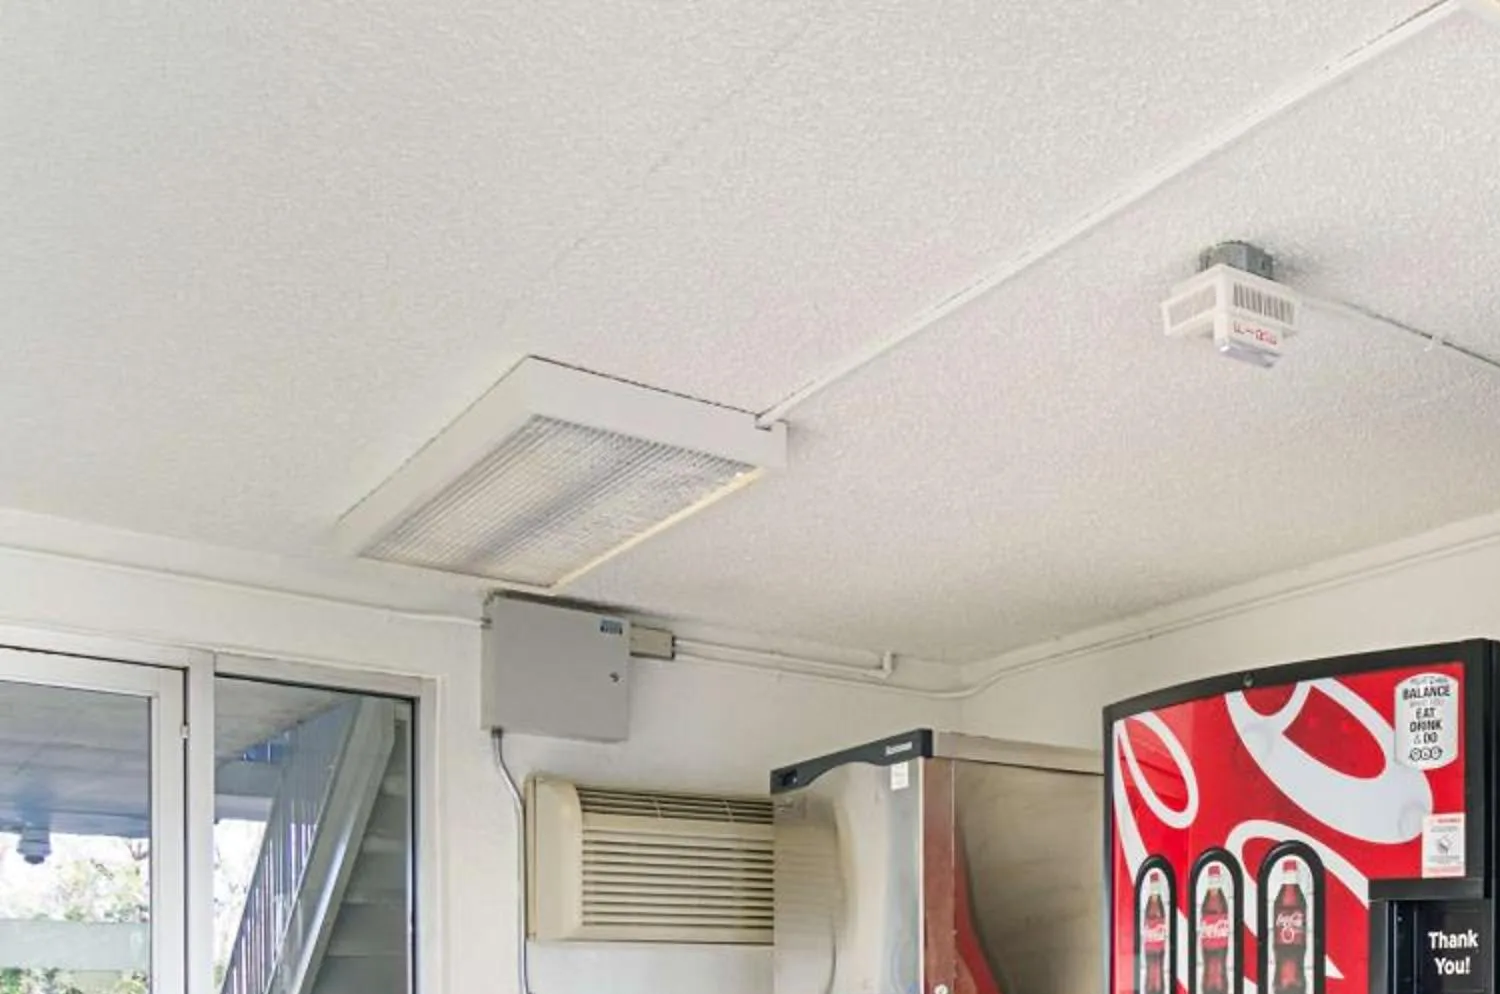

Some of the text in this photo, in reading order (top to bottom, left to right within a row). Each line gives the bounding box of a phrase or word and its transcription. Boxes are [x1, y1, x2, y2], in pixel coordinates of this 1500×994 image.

[1403, 685, 1451, 701] BALANCE
[1415, 707, 1436, 720] EAT
[1409, 720, 1442, 733] DRINK
[1428, 929, 1479, 950] Thank
[1434, 956, 1471, 975] You!
